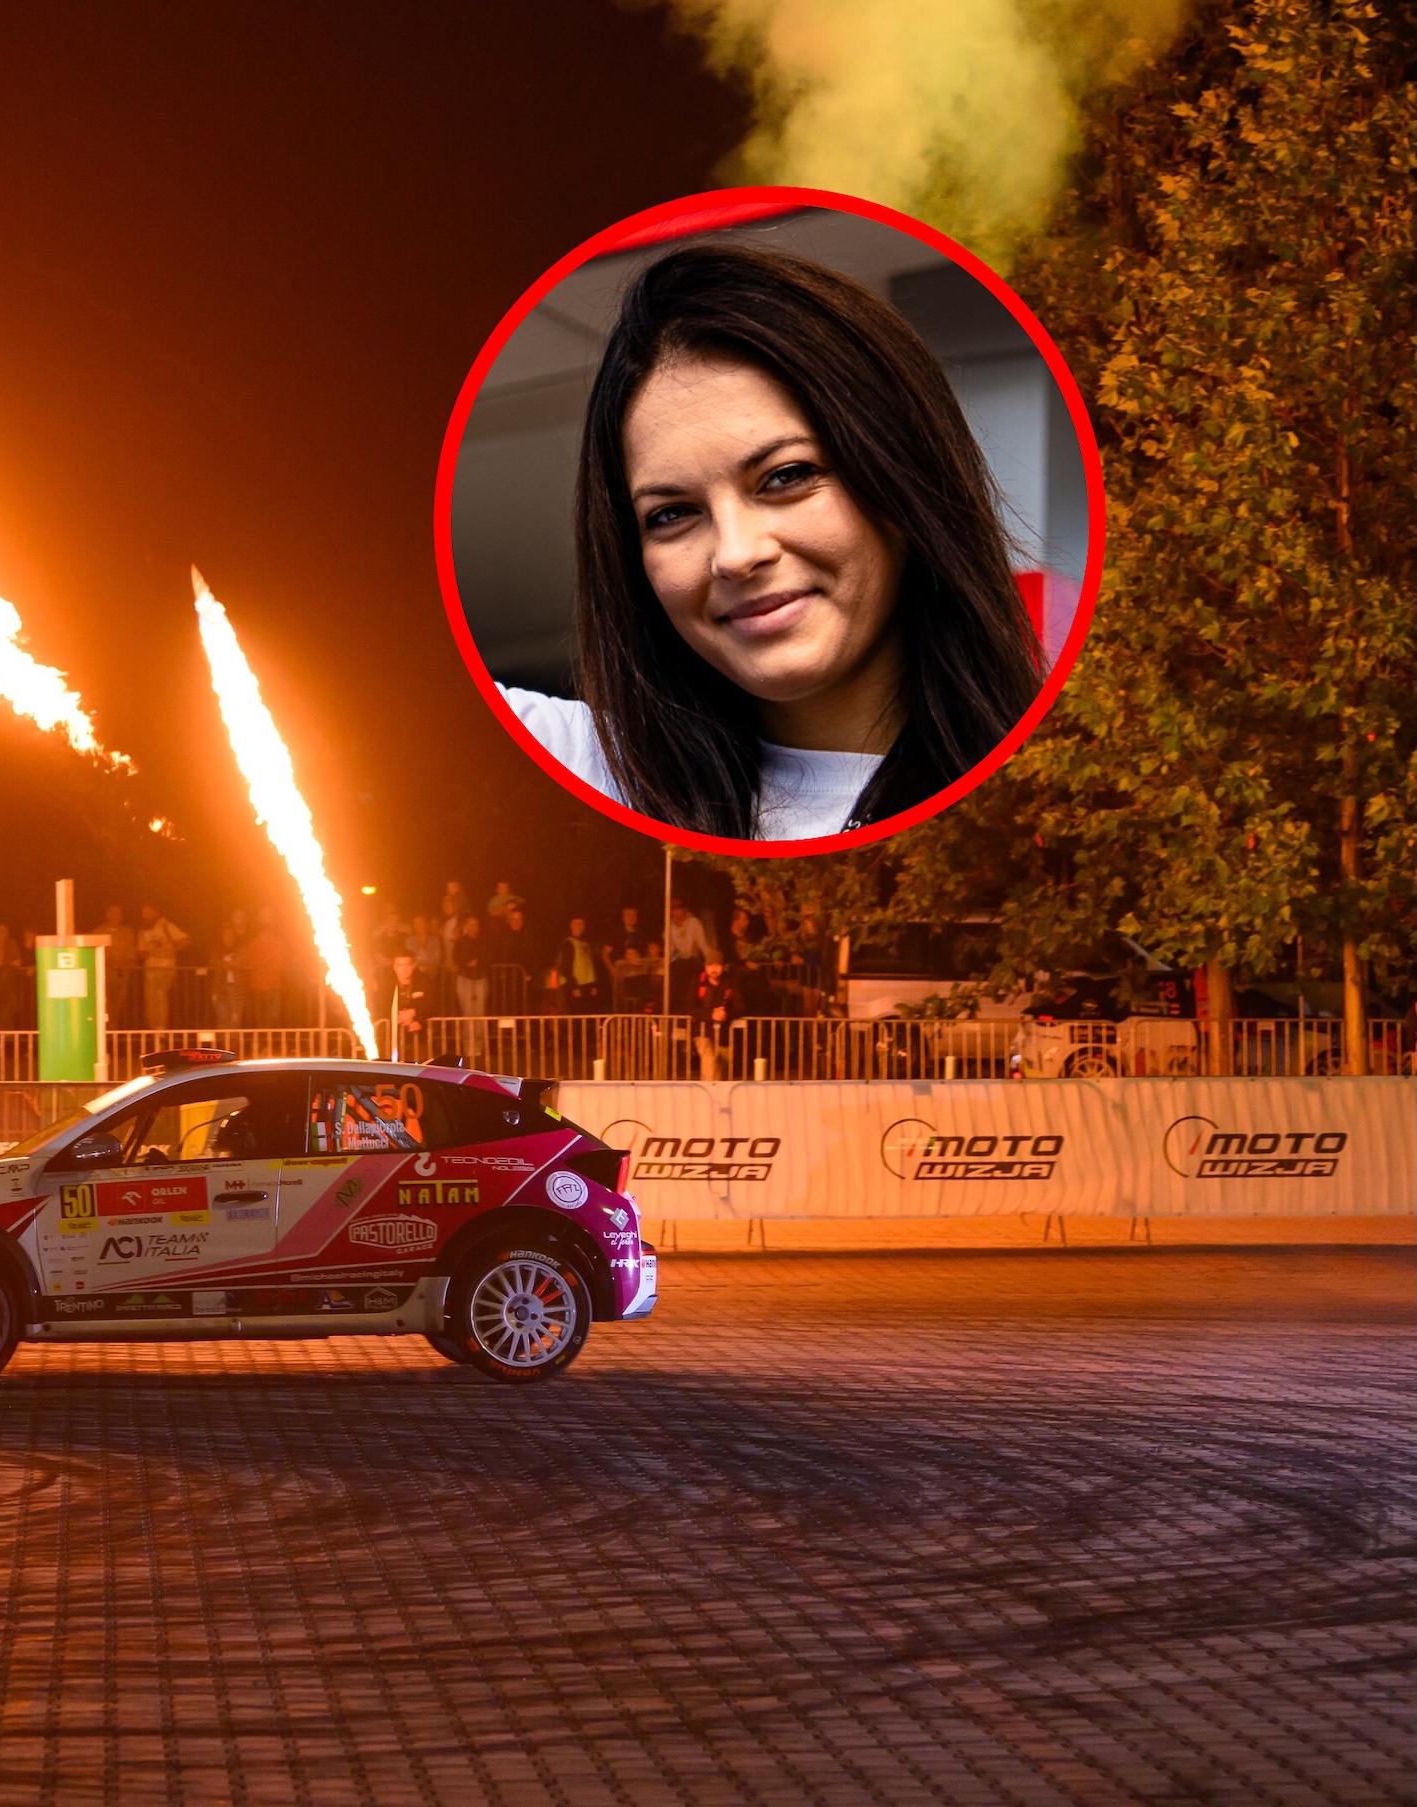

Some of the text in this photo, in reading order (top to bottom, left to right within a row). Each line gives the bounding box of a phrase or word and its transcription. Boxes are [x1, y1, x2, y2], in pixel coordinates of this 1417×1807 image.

[375, 1083, 423, 1120] 50
[640, 1137, 781, 1158] MOTO
[923, 1135, 1064, 1157] MOTO
[1205, 1132, 1347, 1155] MOTO
[635, 1163, 770, 1180] WIZJA
[919, 1162, 1054, 1179] WIZJA
[1199, 1160, 1336, 1177] WIZJA
[63, 1184, 92, 1218] 50
[150, 1186, 189, 1196] ORLEN
[398, 1179, 480, 1205] NATAM
[147, 1232, 197, 1246] TEAM
[352, 1222, 433, 1245] PASTORELLO
[143, 1245, 201, 1257] ITALIA
